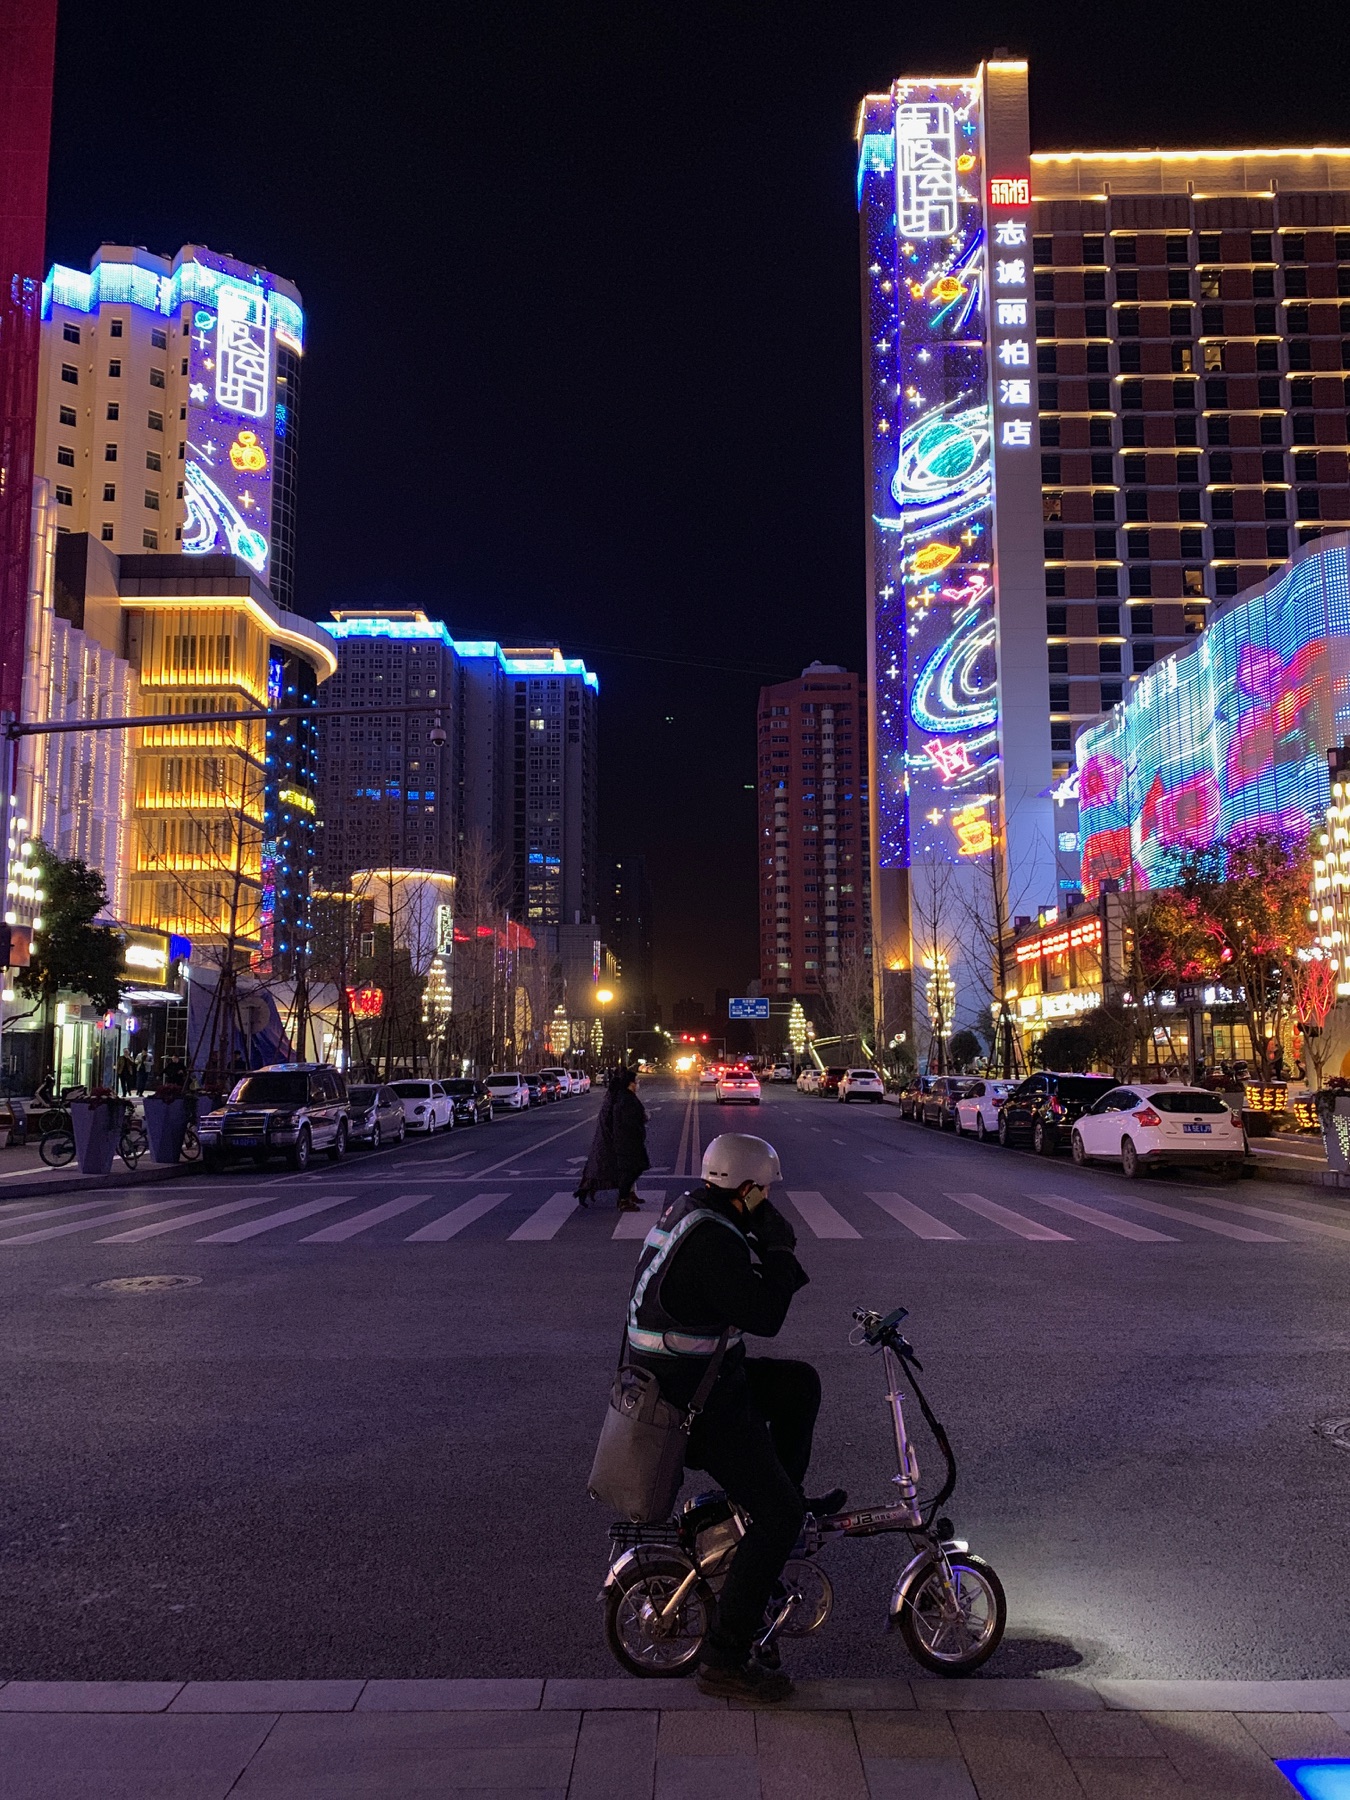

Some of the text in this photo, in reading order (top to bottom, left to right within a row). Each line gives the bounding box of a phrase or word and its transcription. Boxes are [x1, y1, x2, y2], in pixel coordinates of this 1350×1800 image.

[995, 219, 1032, 446] 志诚丽柏酒店
